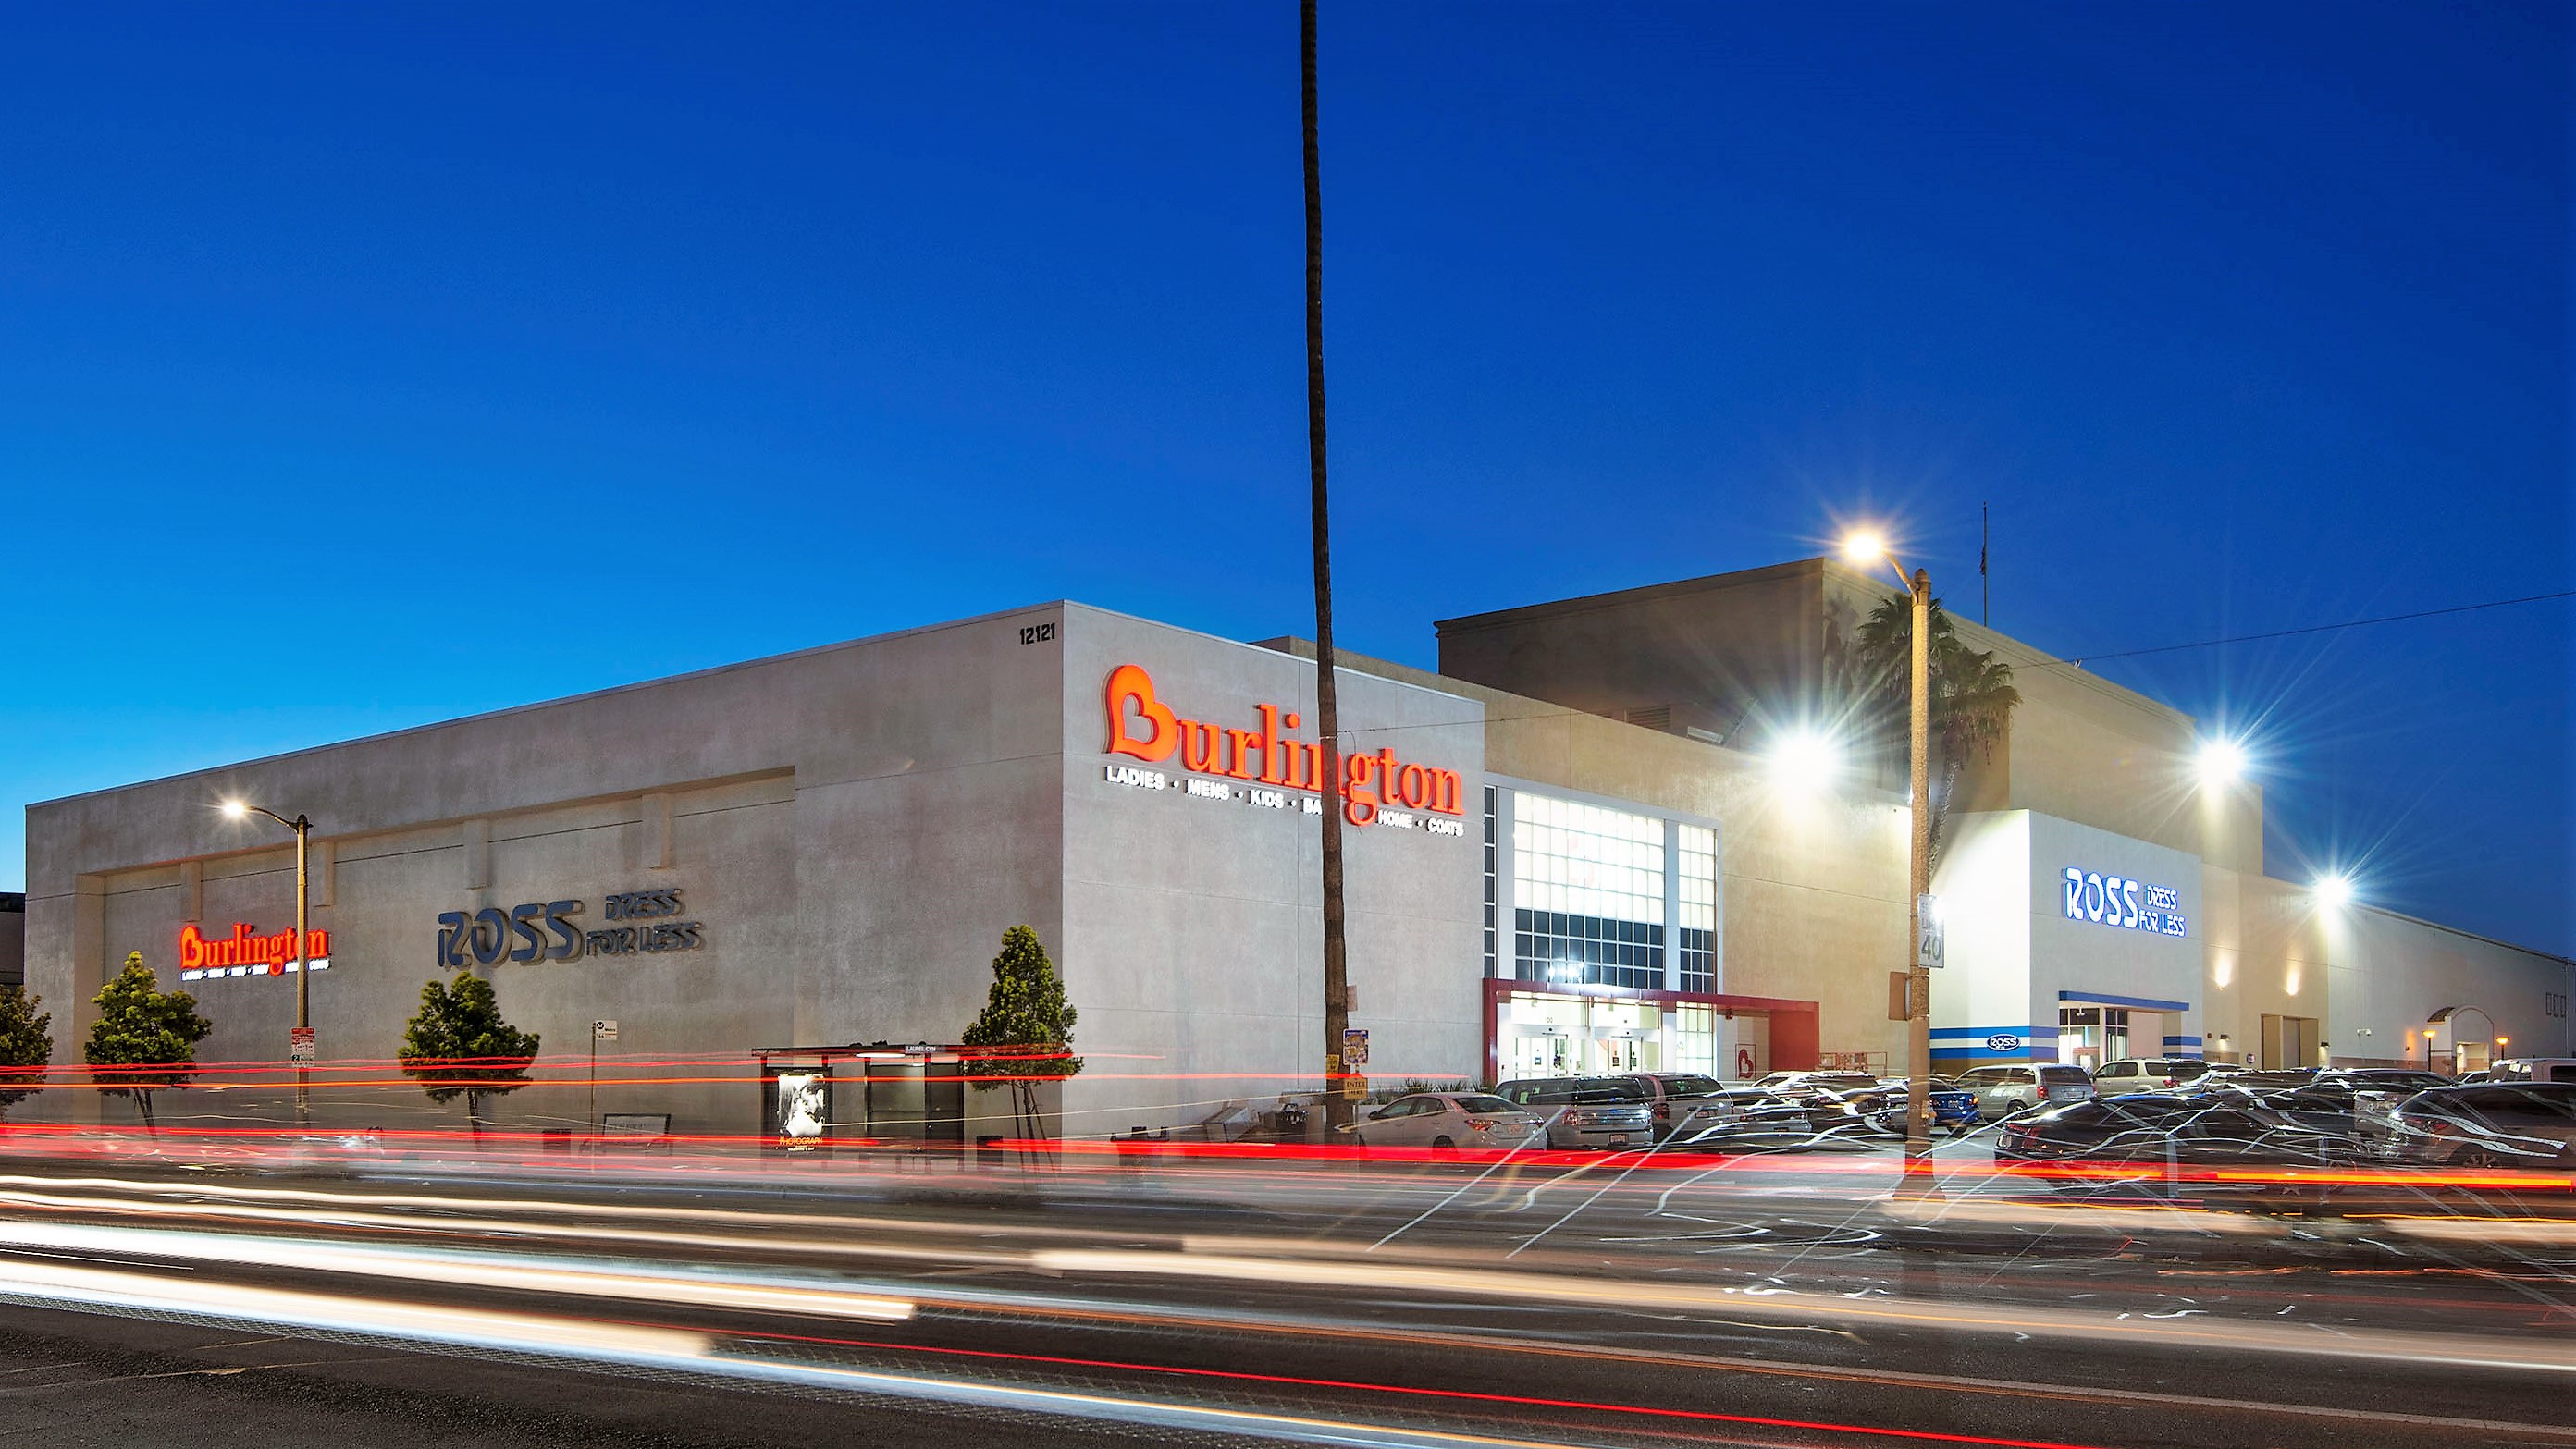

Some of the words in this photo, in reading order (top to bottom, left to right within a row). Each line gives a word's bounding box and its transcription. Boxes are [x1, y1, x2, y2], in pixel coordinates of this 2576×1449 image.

[1020, 622, 1055, 645] 12121
[1105, 664, 1464, 827] Burlington
[1105, 765, 1165, 790] LADIES
[1186, 779, 1229, 800] MENS
[1249, 789, 1284, 808] KIDS
[1302, 797, 1323, 815] BA
[1377, 809, 1413, 829] HOME
[1427, 817, 1464, 837] COATS
[605, 889, 682, 920] DRESS
[2064, 866, 2139, 929] ROSS
[2146, 884, 2177, 910] DRESS
[438, 900, 585, 967] ROSS
[2138, 909, 2159, 933] FOR
[2161, 913, 2186, 938] LESS
[585, 927, 636, 957] FOR
[638, 922, 701, 952] LESS
[1921, 935, 1941, 961] 40
[1990, 1038, 2017, 1047] ROSS
[779, 1136, 822, 1146] PHOTOGRAPH
